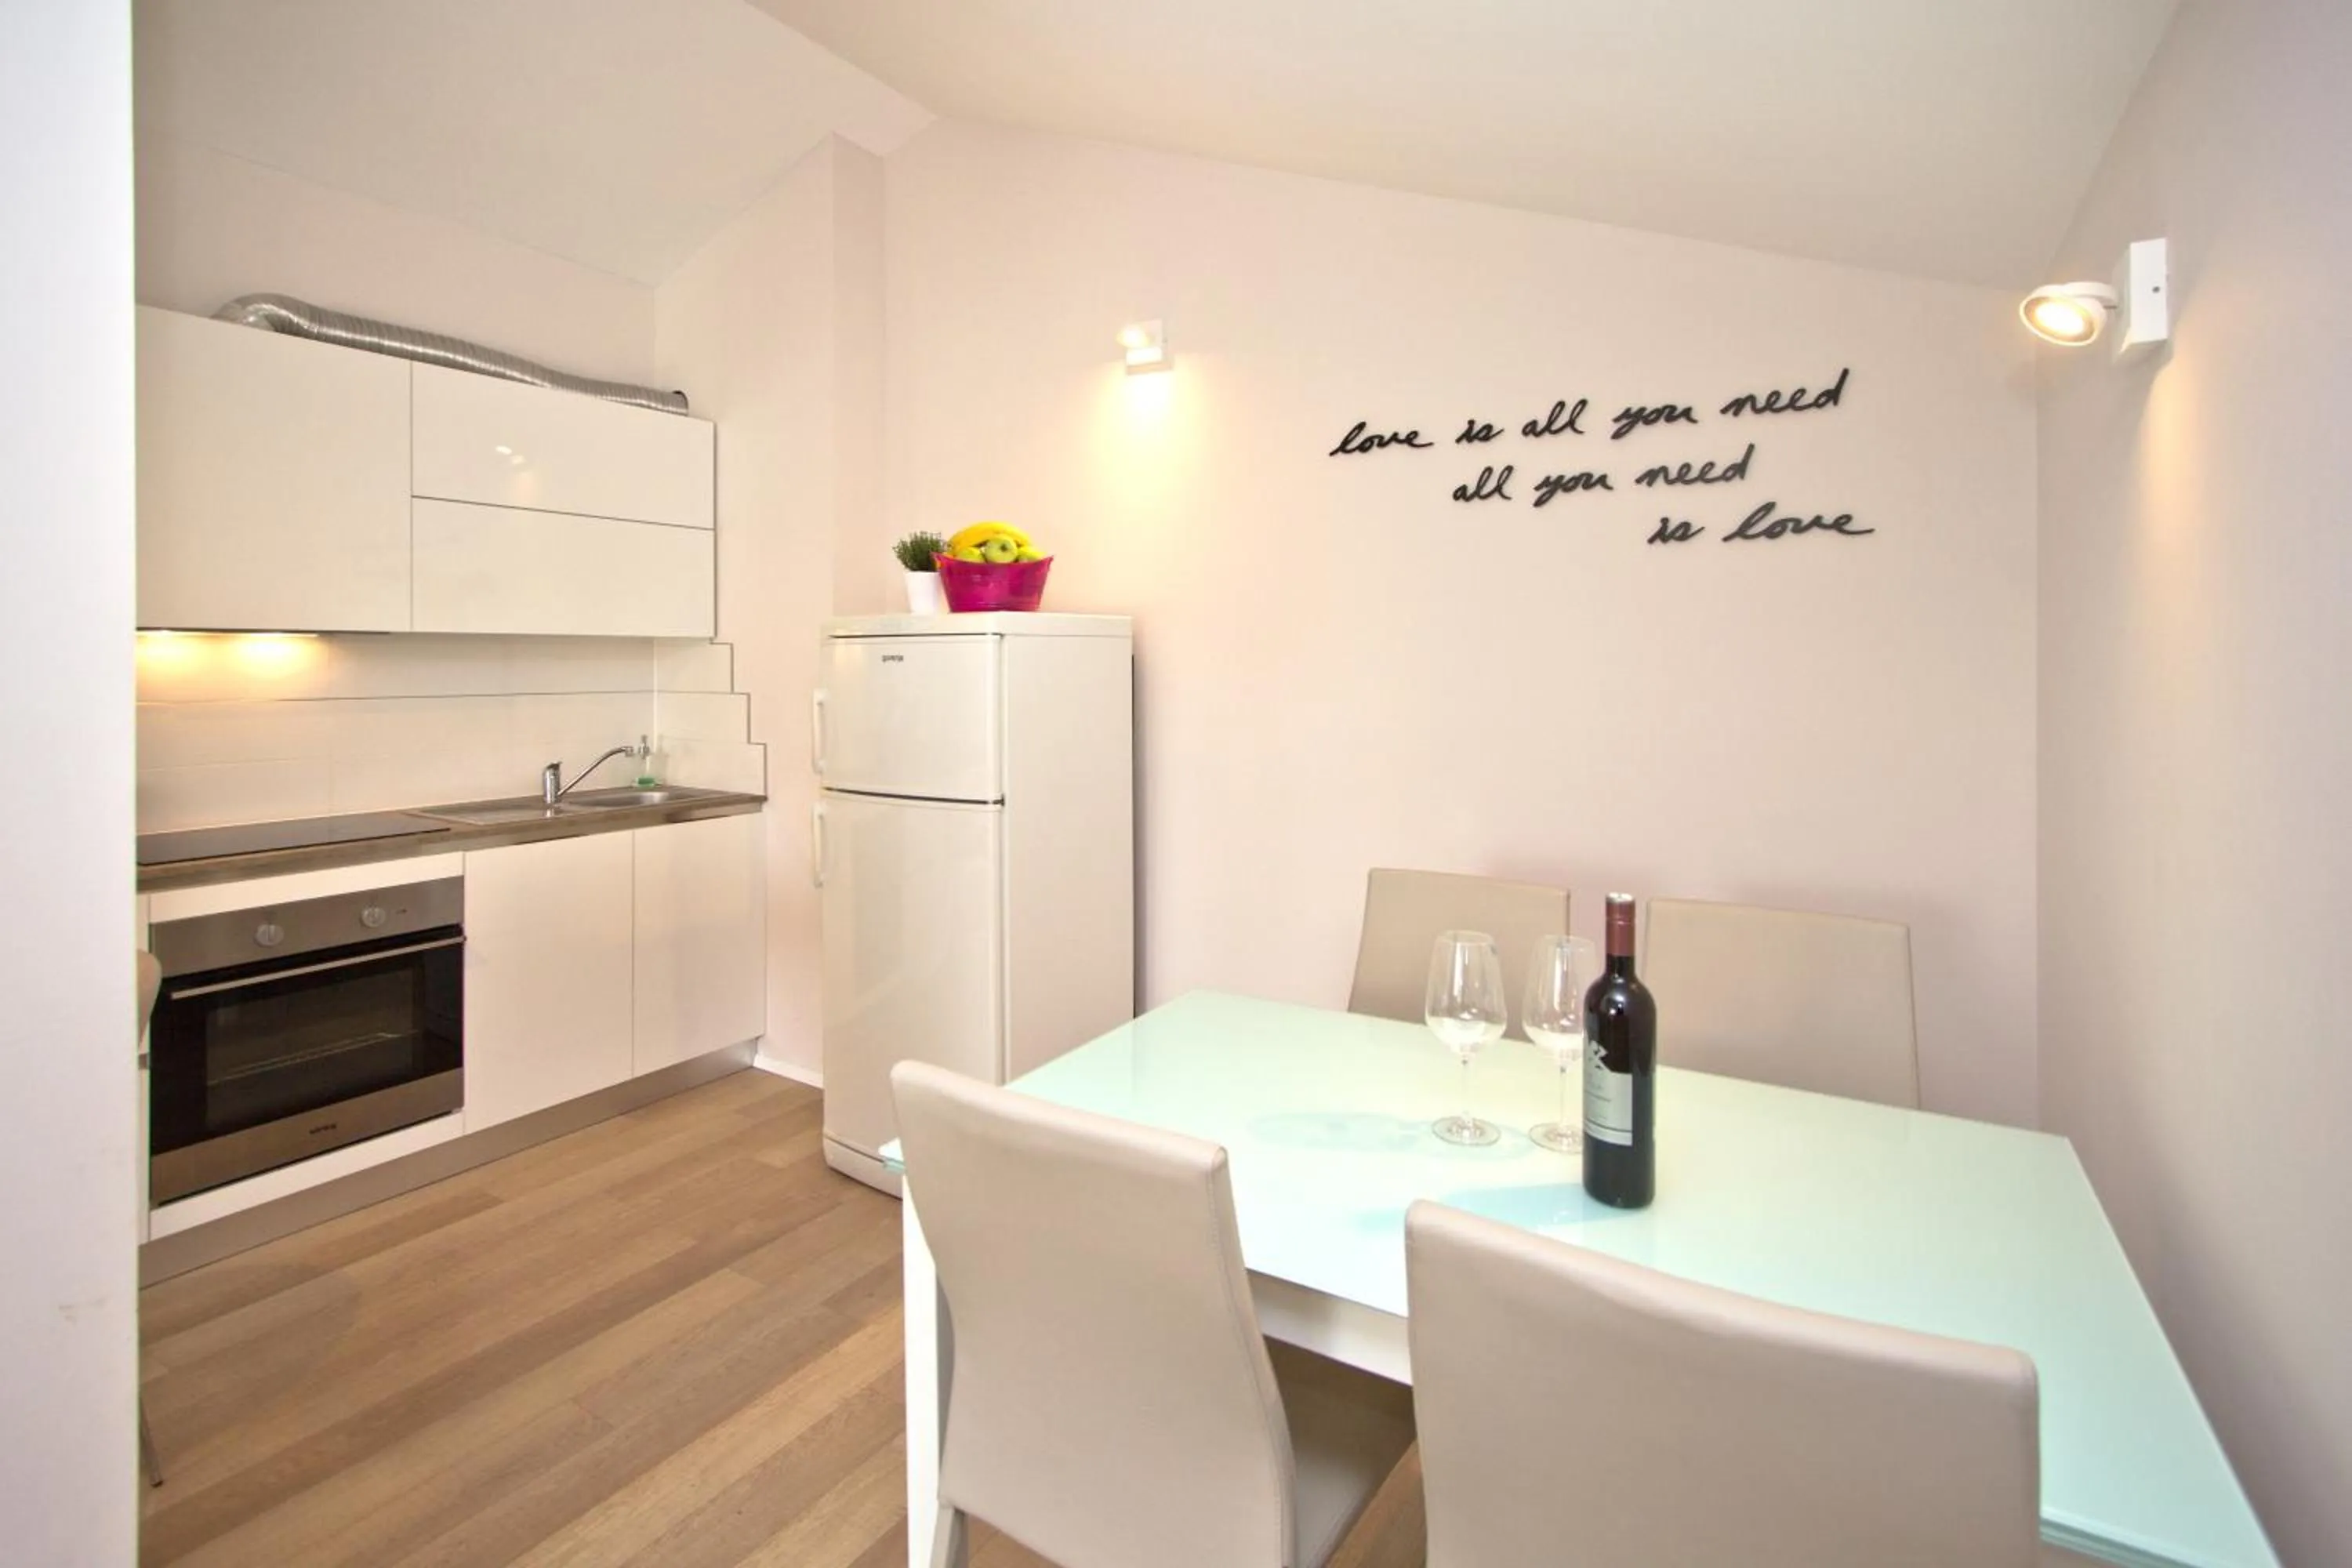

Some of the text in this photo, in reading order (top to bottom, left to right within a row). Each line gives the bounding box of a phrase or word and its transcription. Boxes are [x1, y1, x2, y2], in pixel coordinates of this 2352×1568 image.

[1329, 368, 1849, 457] love is all you need
[1453, 443, 1755, 507] all you need
[1647, 501, 1875, 544] is love
